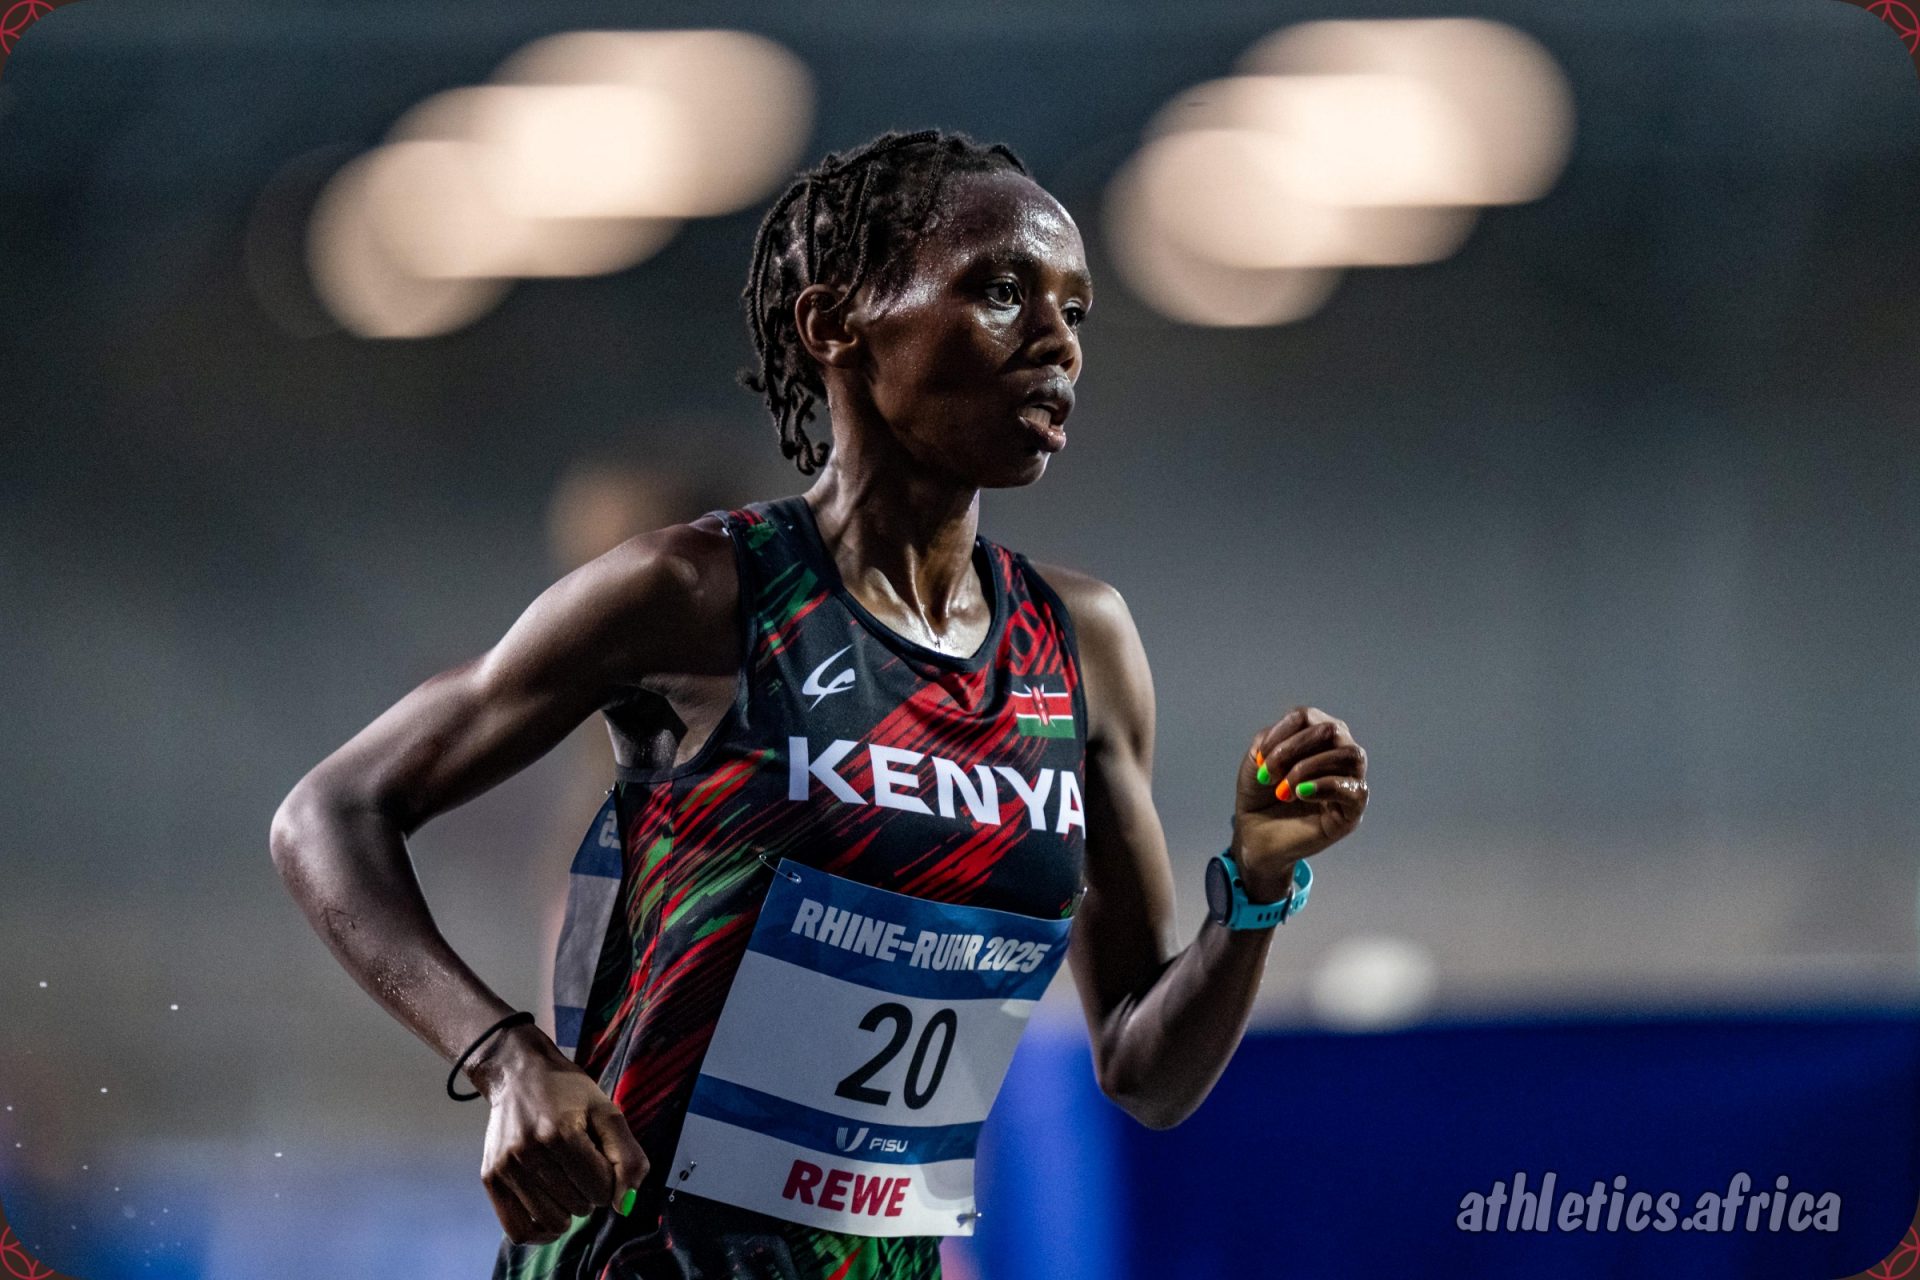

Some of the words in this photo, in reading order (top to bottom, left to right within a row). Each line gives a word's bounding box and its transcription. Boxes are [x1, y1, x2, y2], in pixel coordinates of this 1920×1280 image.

[789, 736, 1086, 839] KENYA
[791, 897, 984, 971] RHINE-RUHR
[978, 937, 1052, 974] 2025
[834, 1002, 957, 1110] 20
[869, 1137, 909, 1153] FISU
[782, 1159, 911, 1217] REWE
